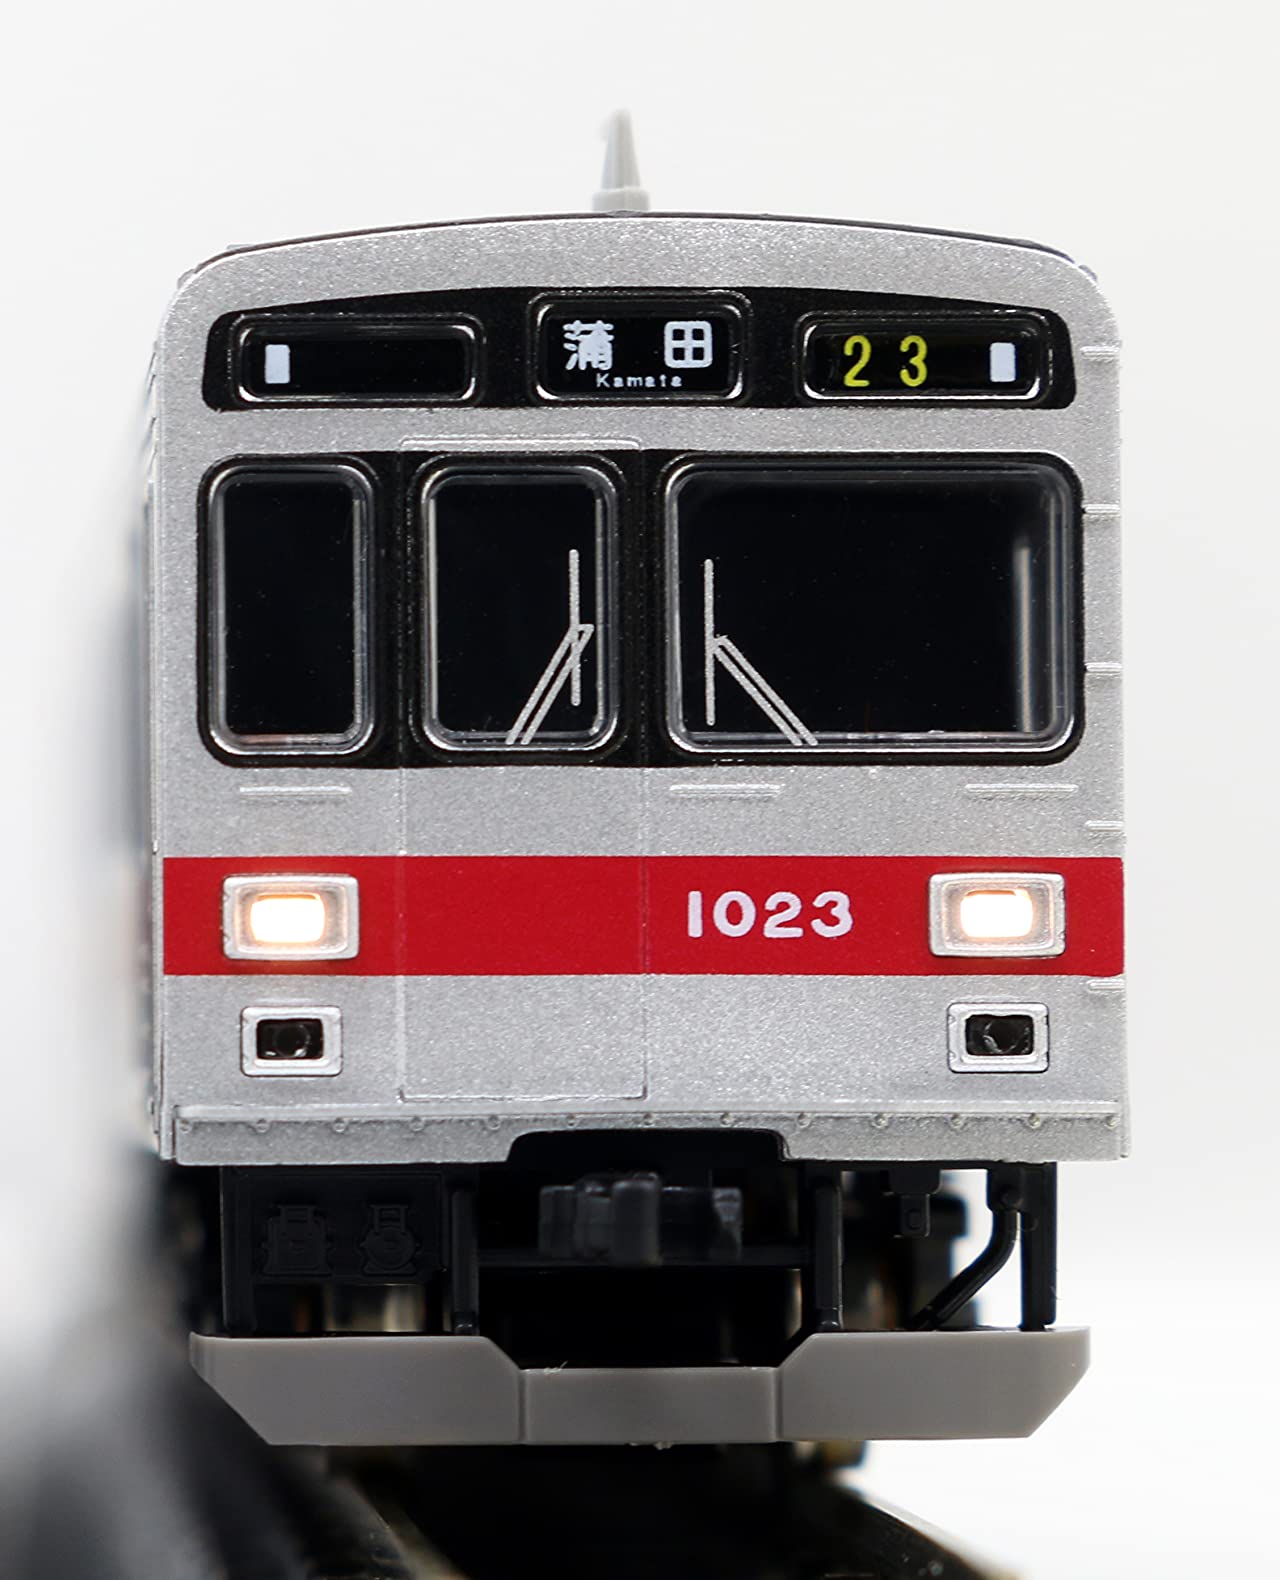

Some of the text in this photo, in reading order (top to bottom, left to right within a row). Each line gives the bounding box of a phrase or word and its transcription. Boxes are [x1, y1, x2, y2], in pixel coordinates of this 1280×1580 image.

[563, 320, 713, 371] 蒲田
[596, 373, 683, 389] Kamata
[686, 890, 853, 939] 1023
